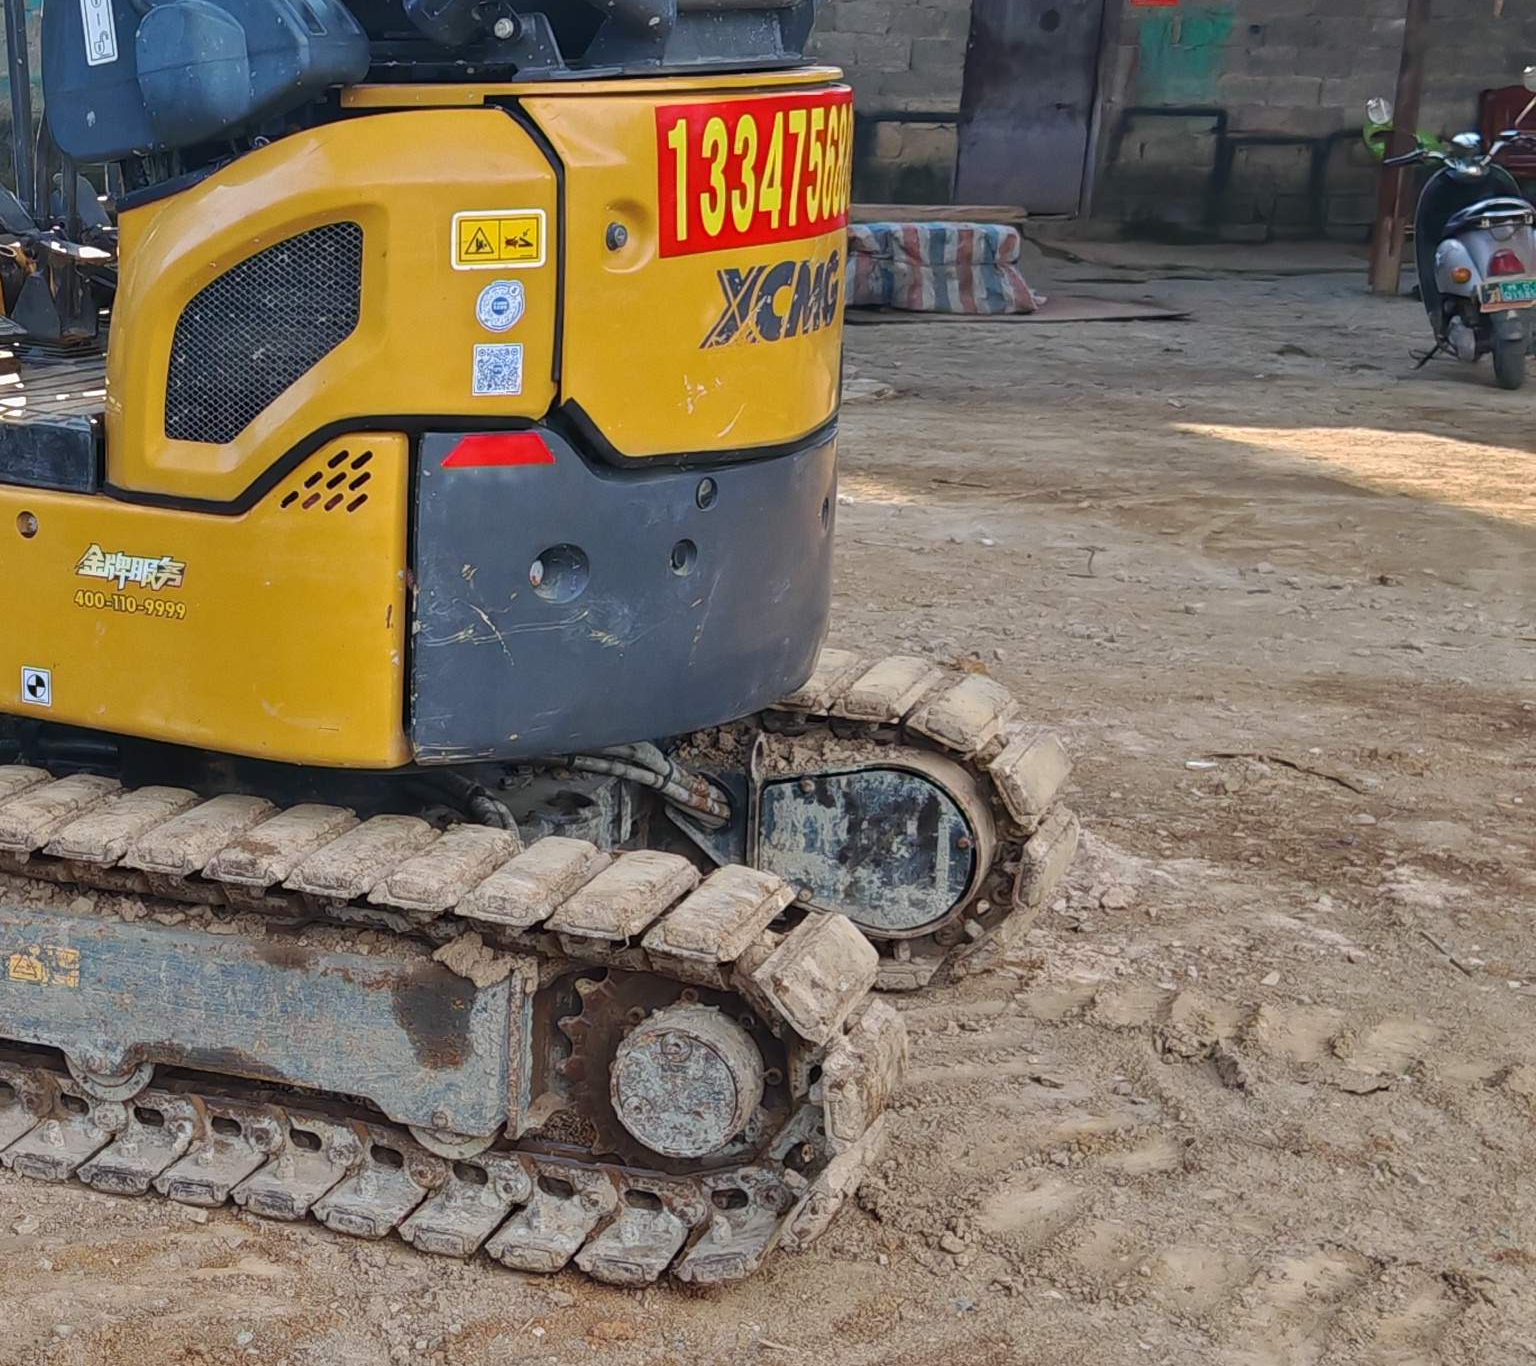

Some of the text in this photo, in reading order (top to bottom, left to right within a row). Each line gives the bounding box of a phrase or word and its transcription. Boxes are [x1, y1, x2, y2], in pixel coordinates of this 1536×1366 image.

[699, 249, 839, 349] XCMG
[75, 543, 186, 590] 金牌服务
[74, 590, 186, 619] 400-110-9999
